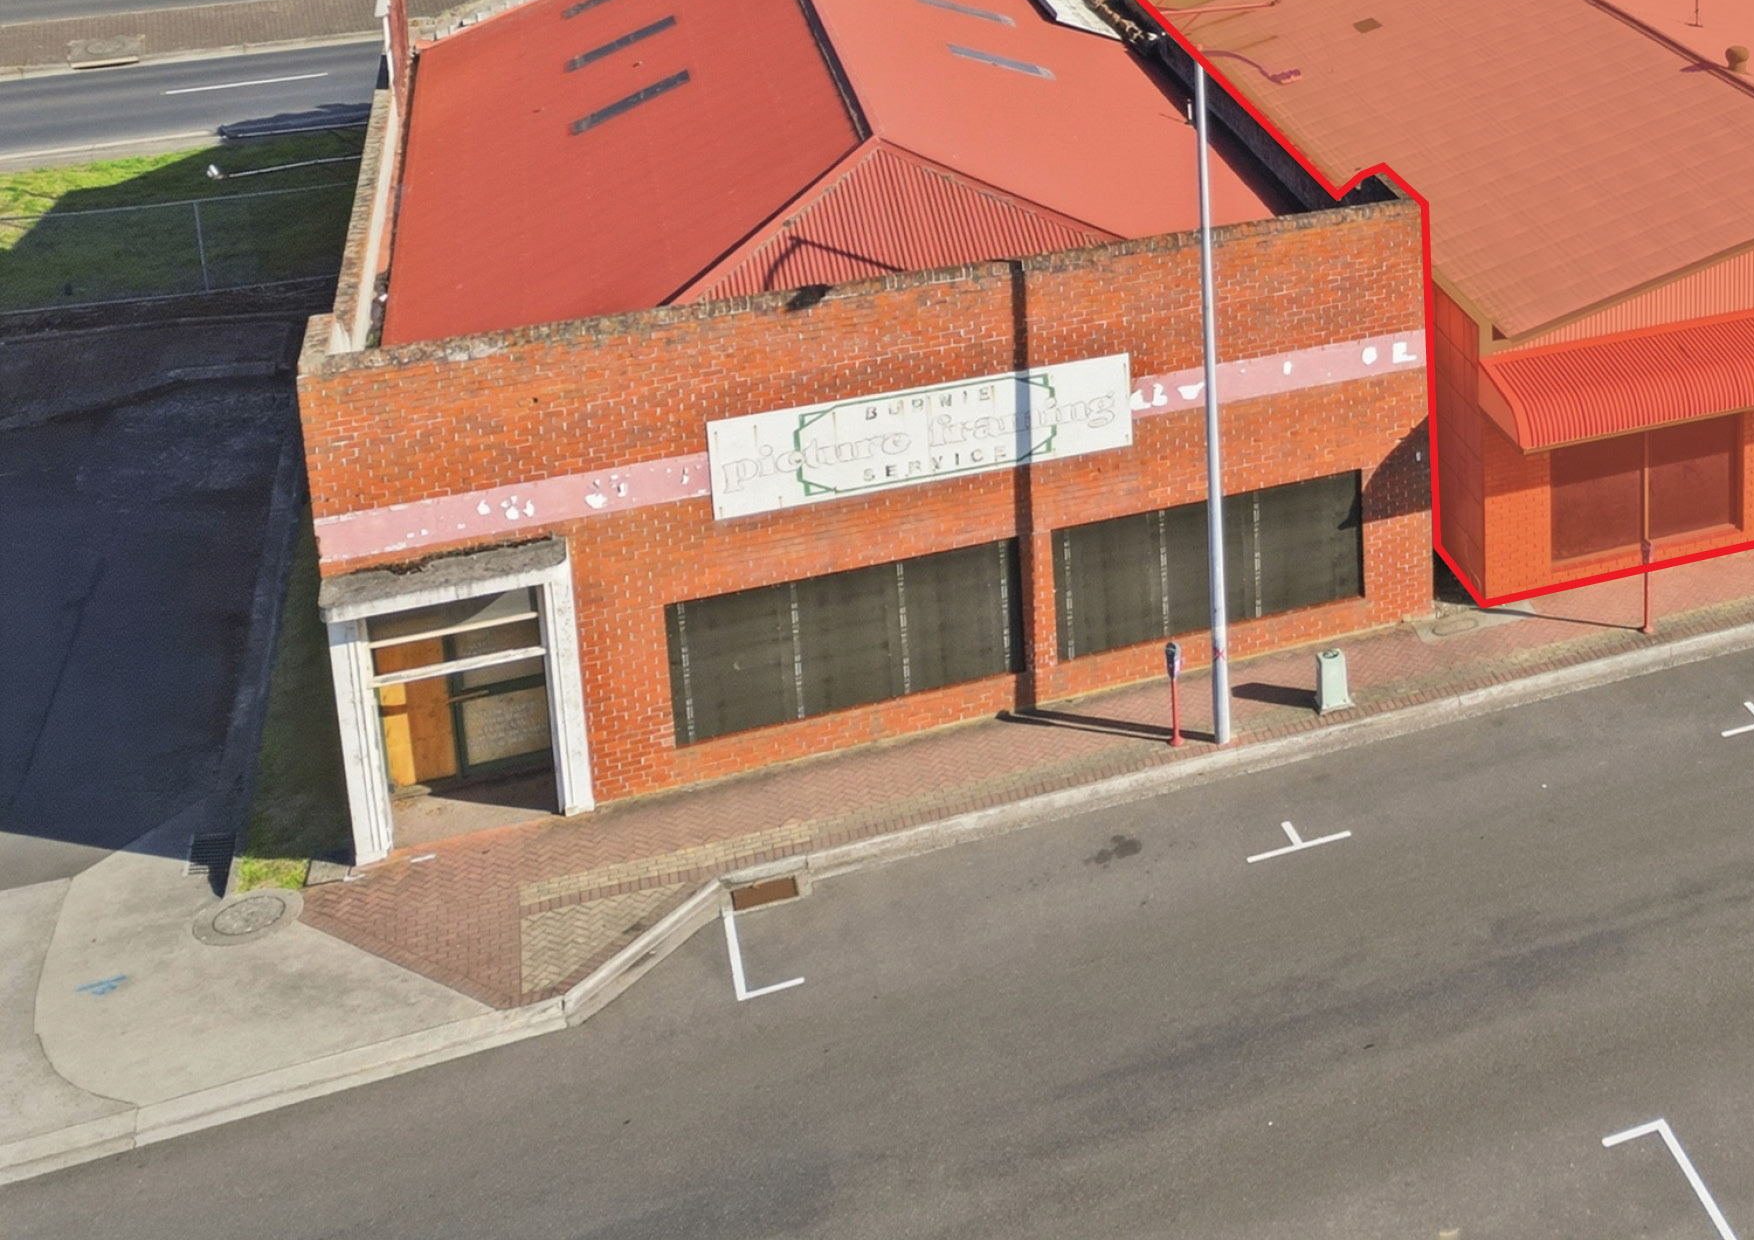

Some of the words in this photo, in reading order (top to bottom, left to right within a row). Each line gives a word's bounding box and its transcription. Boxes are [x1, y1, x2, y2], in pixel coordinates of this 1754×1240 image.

[721, 432, 912, 495] picture
[928, 390, 1115, 448] framing
[863, 446, 1007, 482] SERVICE
